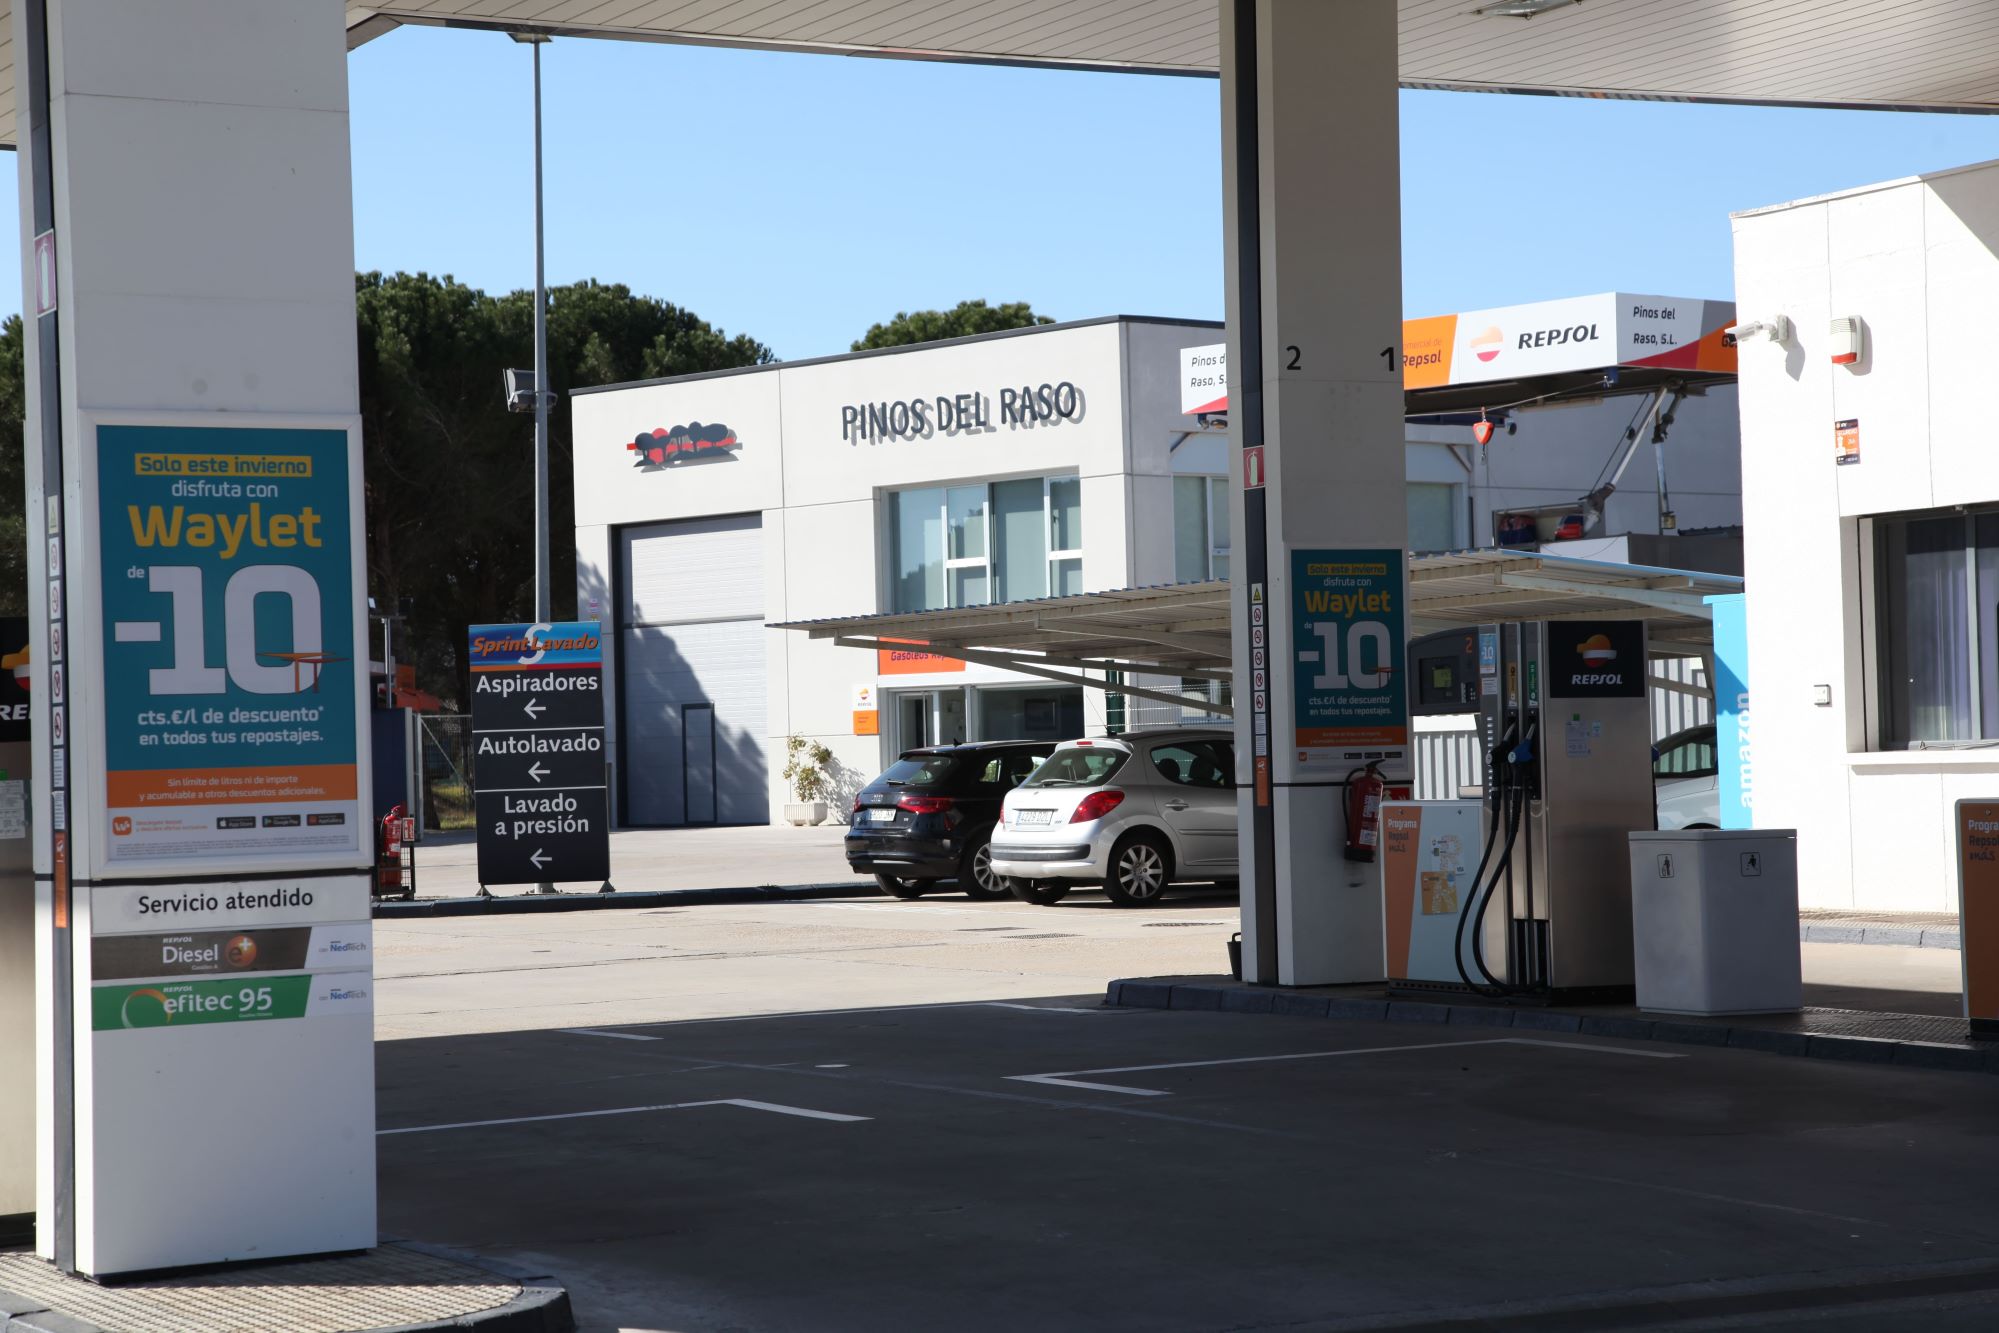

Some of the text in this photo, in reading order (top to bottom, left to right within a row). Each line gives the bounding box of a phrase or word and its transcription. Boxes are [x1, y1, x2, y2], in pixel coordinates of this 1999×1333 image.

[1633, 306, 1676, 321] Pinos del
[1518, 322, 1600, 350] REPSOL
[1633, 332, 1678, 347] Raso, S.L.
[1191, 353, 1226, 367] Pinos d
[1286, 345, 1301, 370] 2
[1380, 346, 1395, 371] 1
[1402, 349, 1442, 369] Repsol
[1190, 374, 1227, 389] Raso, S.
[842, 381, 1078, 440] PINOS DEL RASO
[140, 456, 307, 474] Solo este invierno
[172, 479, 279, 497] disfruta con
[127, 502, 322, 560] Waylet
[1324, 577, 1355, 587] disfruta
[1304, 589, 1391, 618] Waylet
[114, 564, 323, 696] de -10
[472, 633, 599, 656] Sprint Lavado
[1465, 636, 1473, 653] 2
[1298, 620, 1392, 689] de -10
[476, 672, 598, 697] Aspiradores
[1571, 673, 1623, 686] REPSOL
[1337, 695, 1347, 705] de
[0, 703, 30, 721] RE
[138, 708, 197, 726] cts.€/l
[203, 707, 224, 724] de
[1320, 707, 1340, 716] todos
[1341, 707, 1353, 716] tus
[1354, 706, 1392, 717] repostajes.
[139, 726, 325, 746] en todos tus repostajes.
[478, 732, 600, 755] Autolavado
[1736, 692, 1753, 809] amazon
[167, 778, 182, 787] Sin
[208, 777, 219, 786] de
[221, 776, 243, 785] litros
[244, 776, 252, 785] ni
[254, 776, 264, 785] de
[266, 775, 298, 786] importe
[139, 794, 145, 802] y
[146, 791, 197, 801] acumulable
[198, 792, 204, 800] a
[205, 790, 228, 799] otros
[229, 788, 277, 799] descuentos
[504, 793, 577, 814] Lavado
[495, 814, 589, 840] a presión
[138, 887, 313, 915] Servicio atendido
[162, 935, 193, 944] REPSOL
[330, 942, 367, 952] NeoTech
[162, 943, 218, 964] Diesel
[163, 985, 193, 993] REPSOL
[330, 990, 367, 1000] NeoTech
[163, 987, 273, 1014] efitec 95
